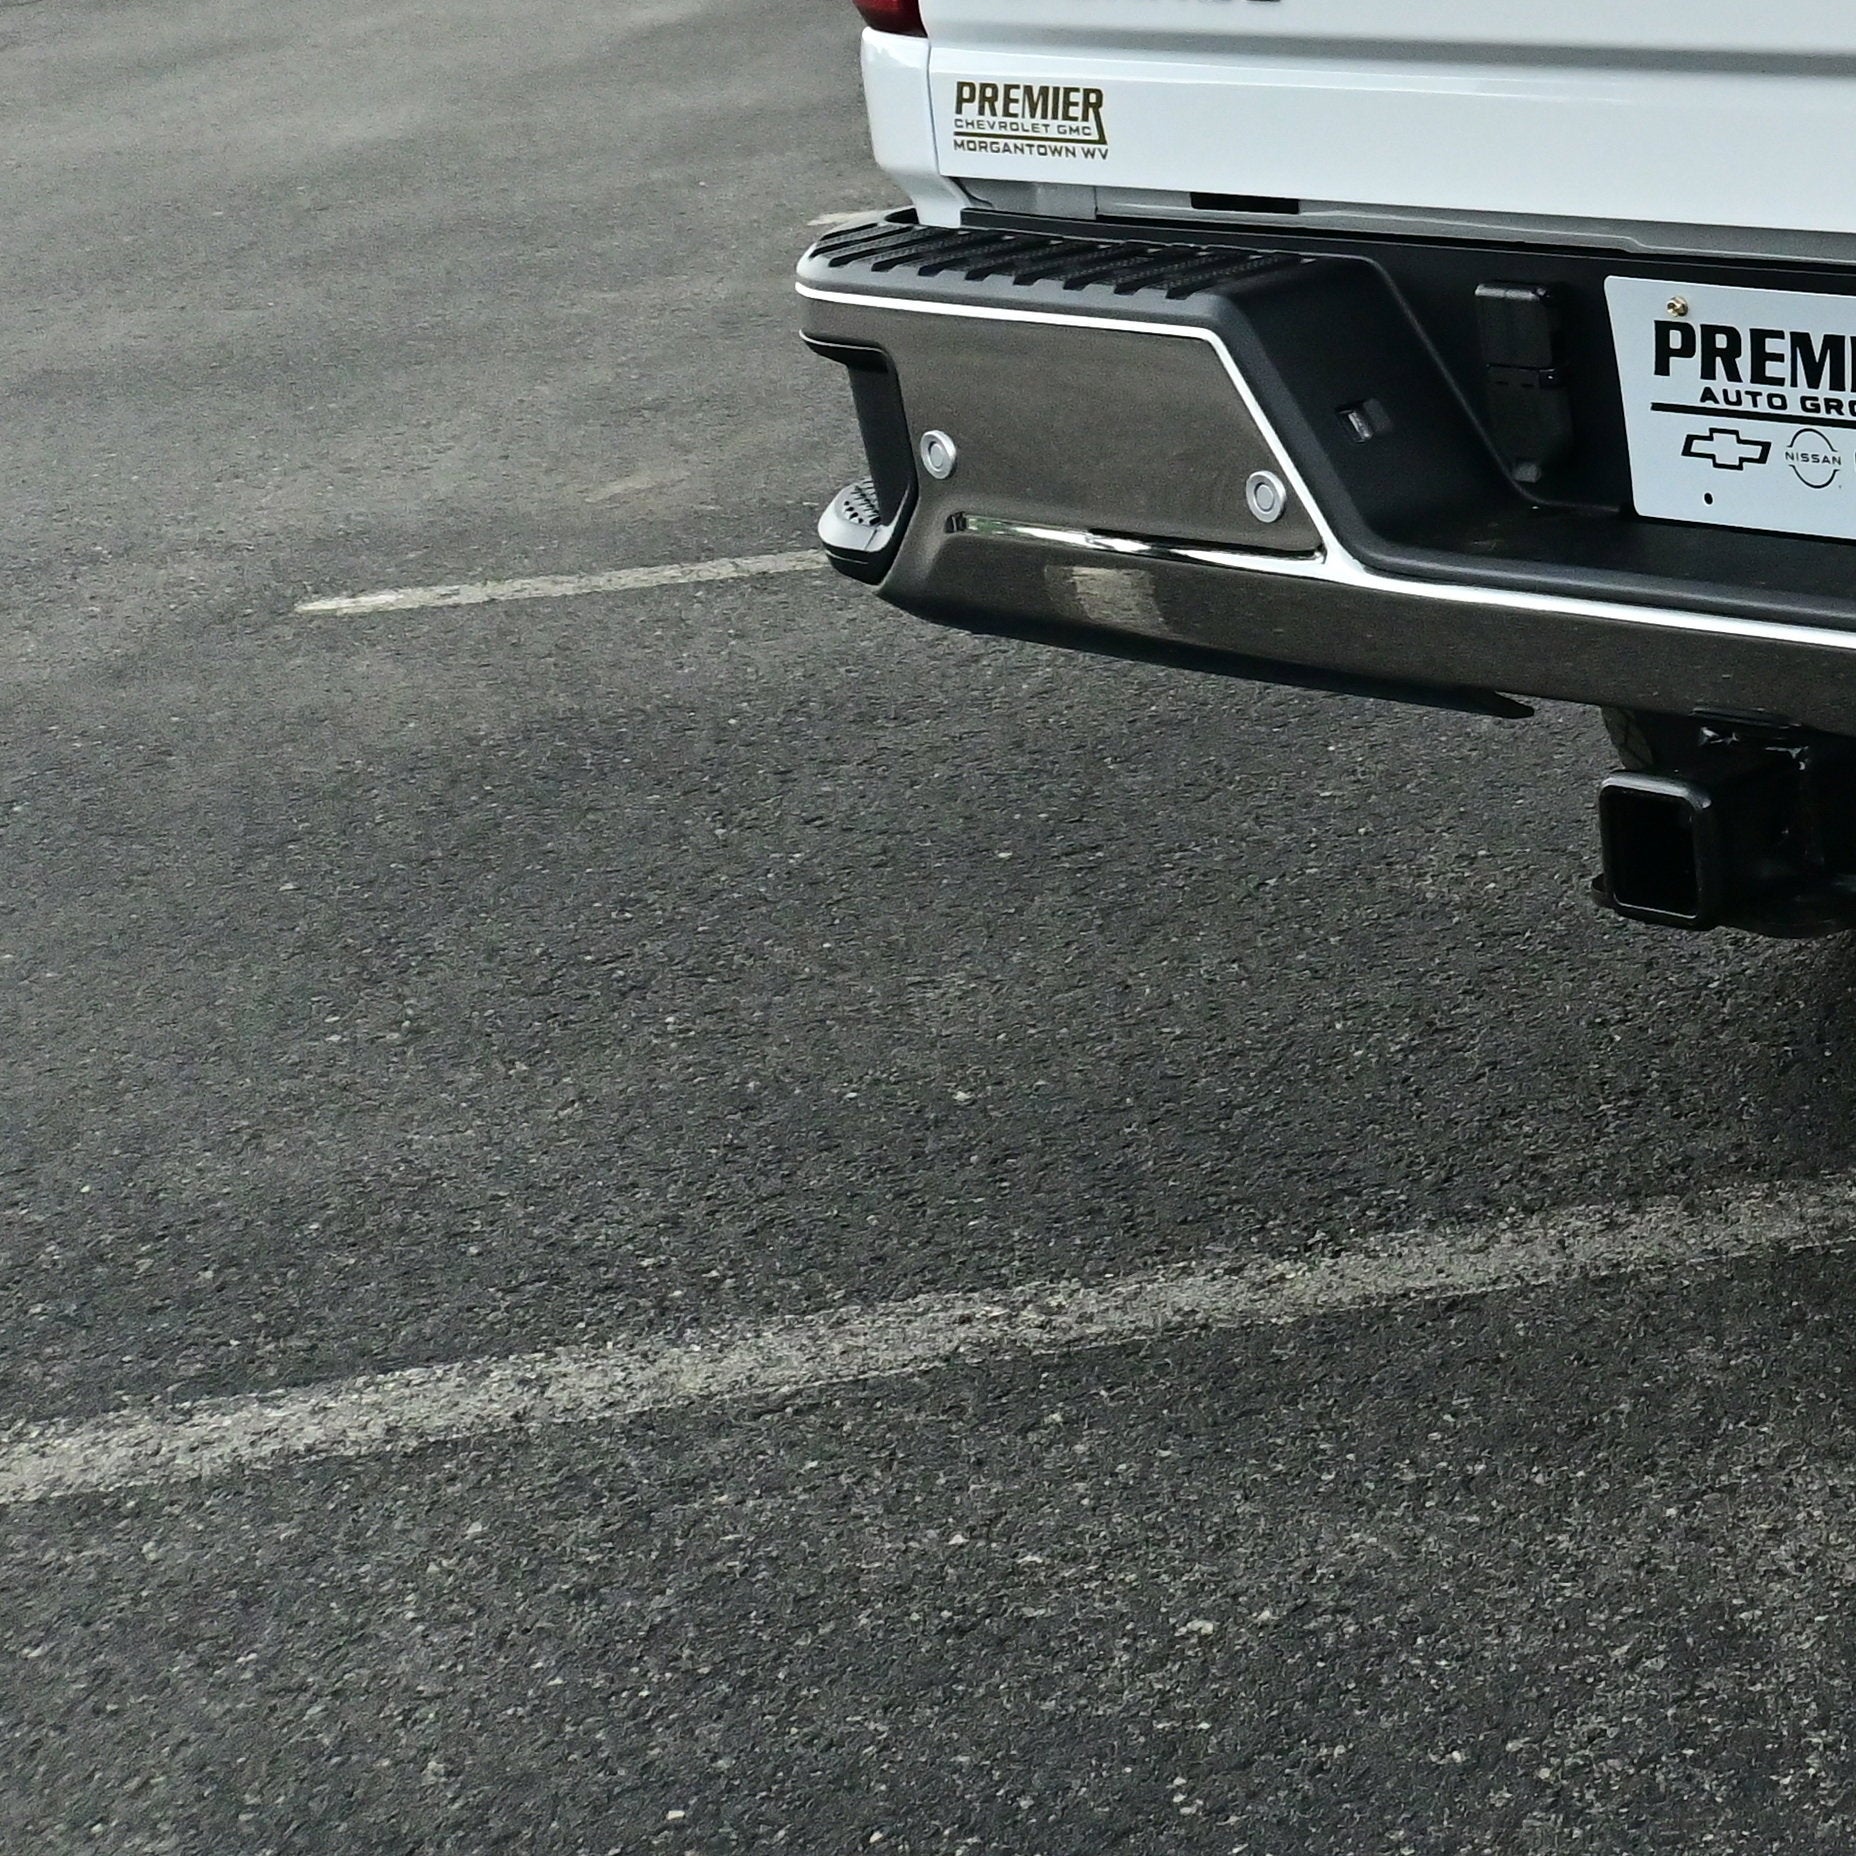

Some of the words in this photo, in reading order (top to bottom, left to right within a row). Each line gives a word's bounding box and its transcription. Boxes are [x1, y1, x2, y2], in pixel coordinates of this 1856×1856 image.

[954, 80, 1106, 139] PREMIER
[954, 117, 1050, 134] CHEVROLET
[1056, 124, 1093, 137] GMC
[952, 138, 1077, 159] MORGANTOWN
[1080, 146, 1109, 161] WV
[1699, 386, 1788, 412] AUTO
[1784, 450, 1843, 467] NISSAN
